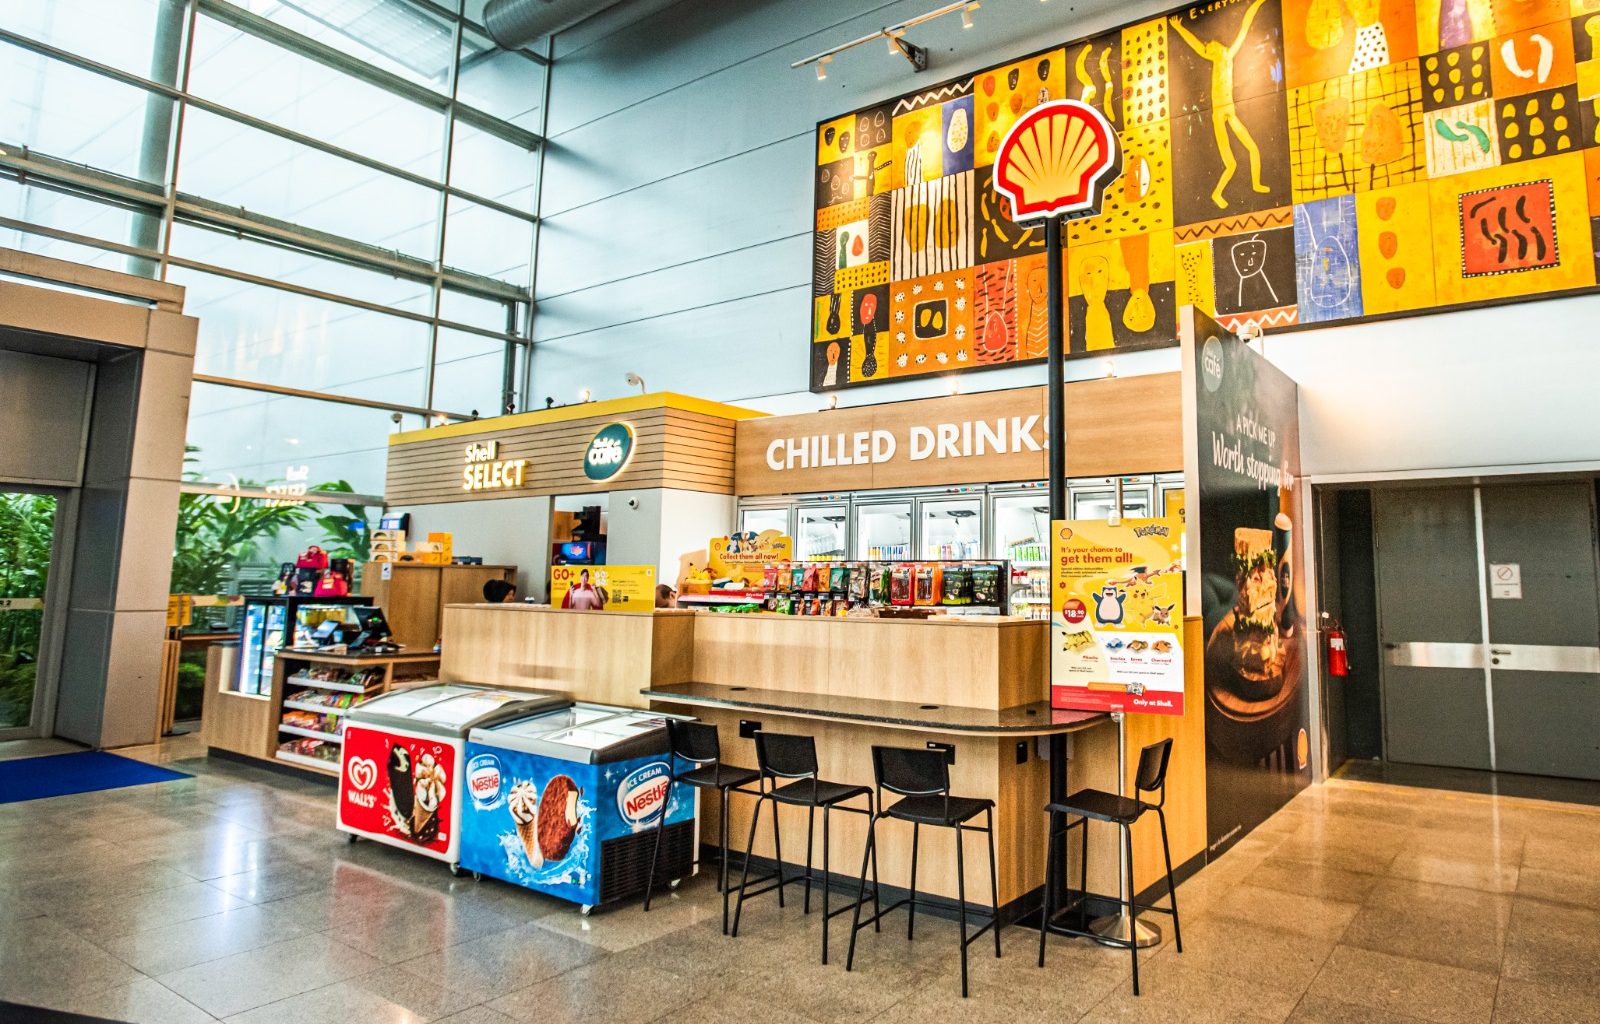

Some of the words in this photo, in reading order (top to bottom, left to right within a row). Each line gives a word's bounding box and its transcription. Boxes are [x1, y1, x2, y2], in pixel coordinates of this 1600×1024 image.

[766, 429, 897, 471] CHILLED
[909, 414, 1067, 462] DRINK
[1242, 415, 1258, 441] PICK
[1267, 428, 1276, 449] UP
[464, 440, 497, 463] Shell
[1212, 430, 1245, 475] Worth
[1246, 452, 1281, 497] stopping
[463, 460, 527, 490] SELECT
[1060, 555, 1080, 566] get
[1082, 553, 1112, 563] them
[1115, 552, 1133, 563] all!
[1133, 699, 1148, 707] Only
[638, 767, 662, 782] CREAM
